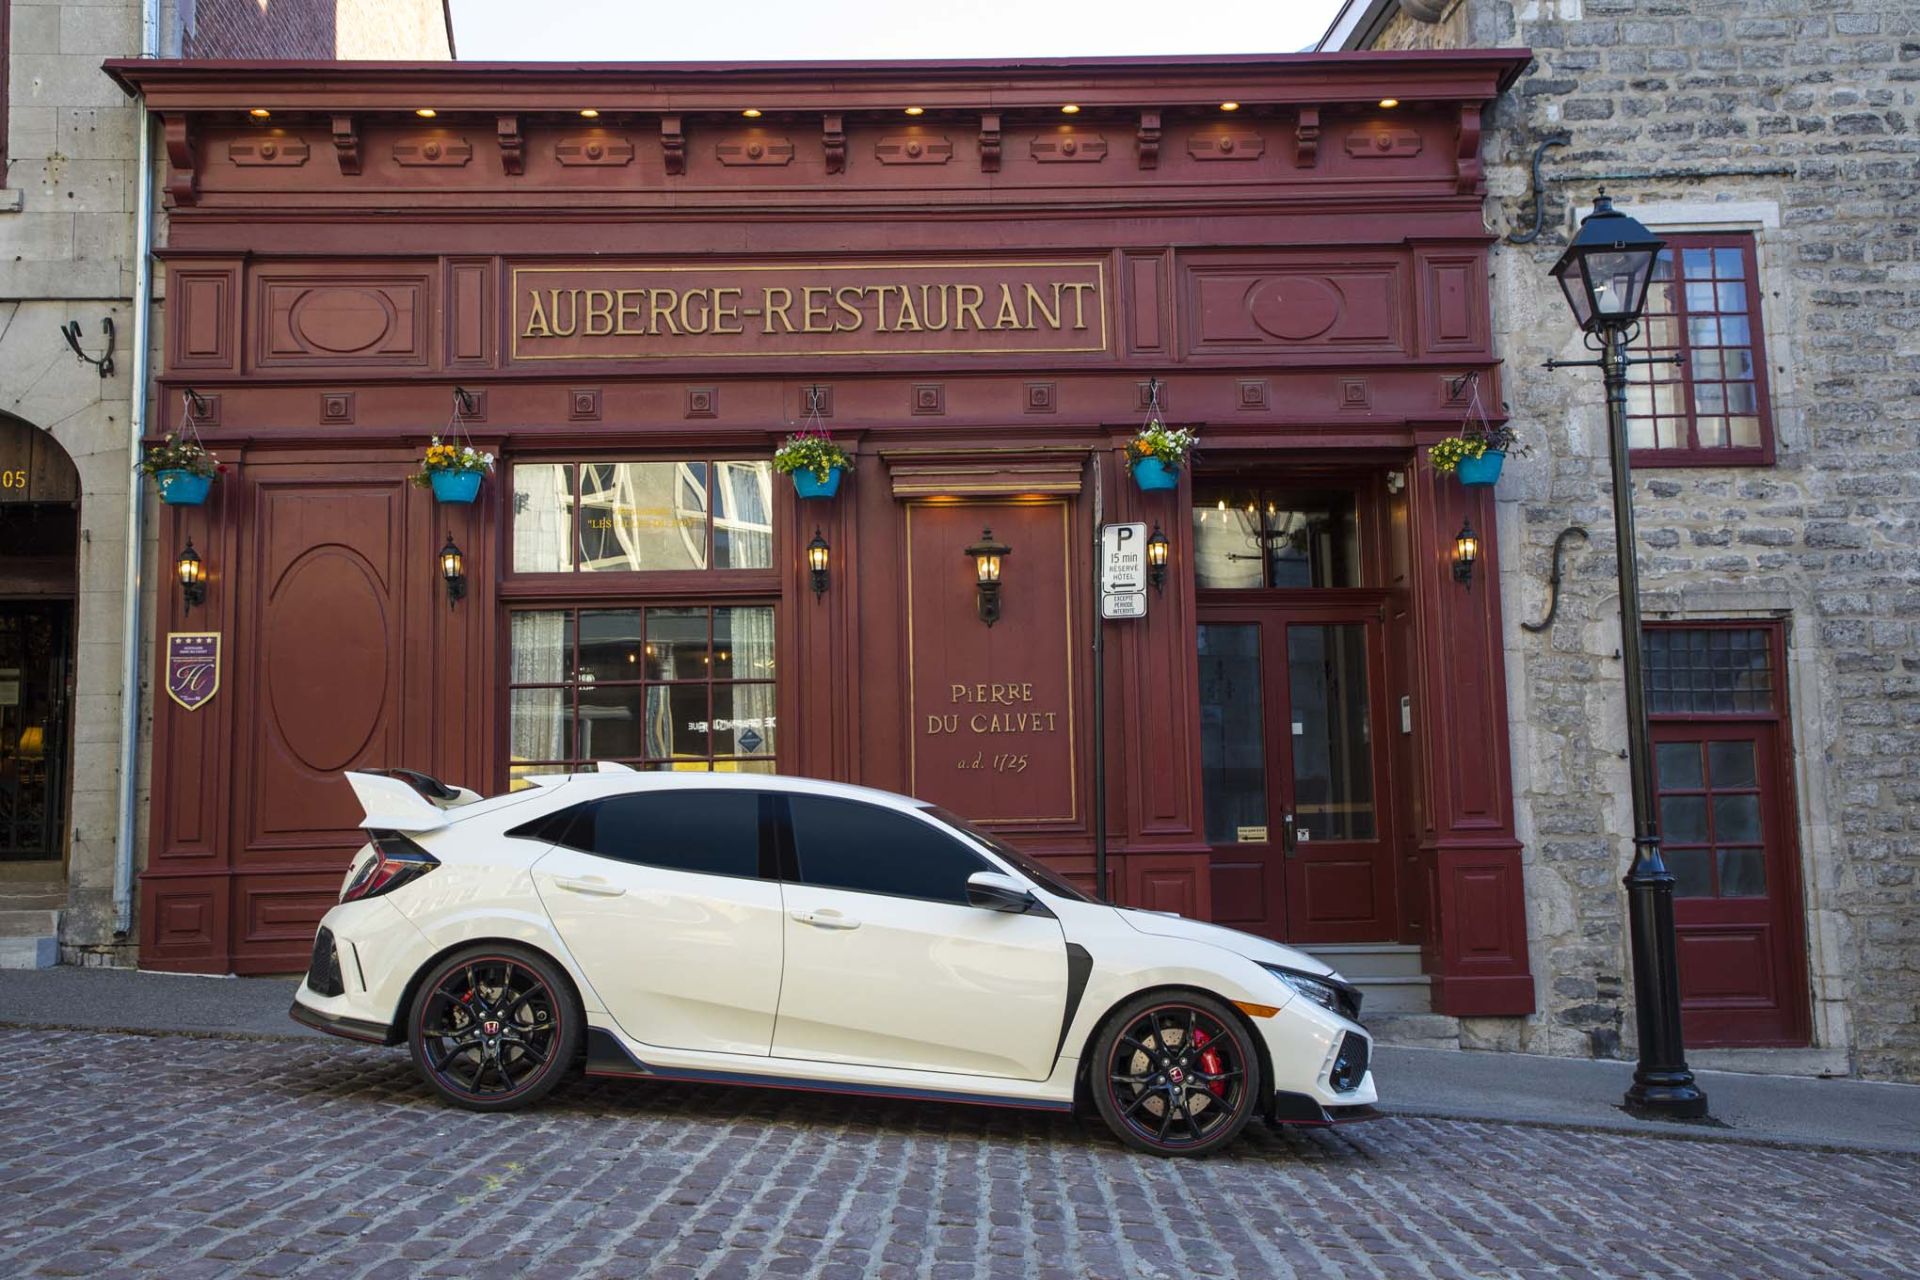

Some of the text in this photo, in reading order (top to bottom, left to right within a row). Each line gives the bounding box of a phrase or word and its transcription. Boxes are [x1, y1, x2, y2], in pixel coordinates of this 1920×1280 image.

[521, 282, 1095, 338] AUBERGE-RESTAURANT
[1117, 527, 1133, 552] P
[1110, 551, 1138, 564] 15 min
[927, 712, 1057, 734] DU CALVET
[993, 753, 1029, 773] 1725
